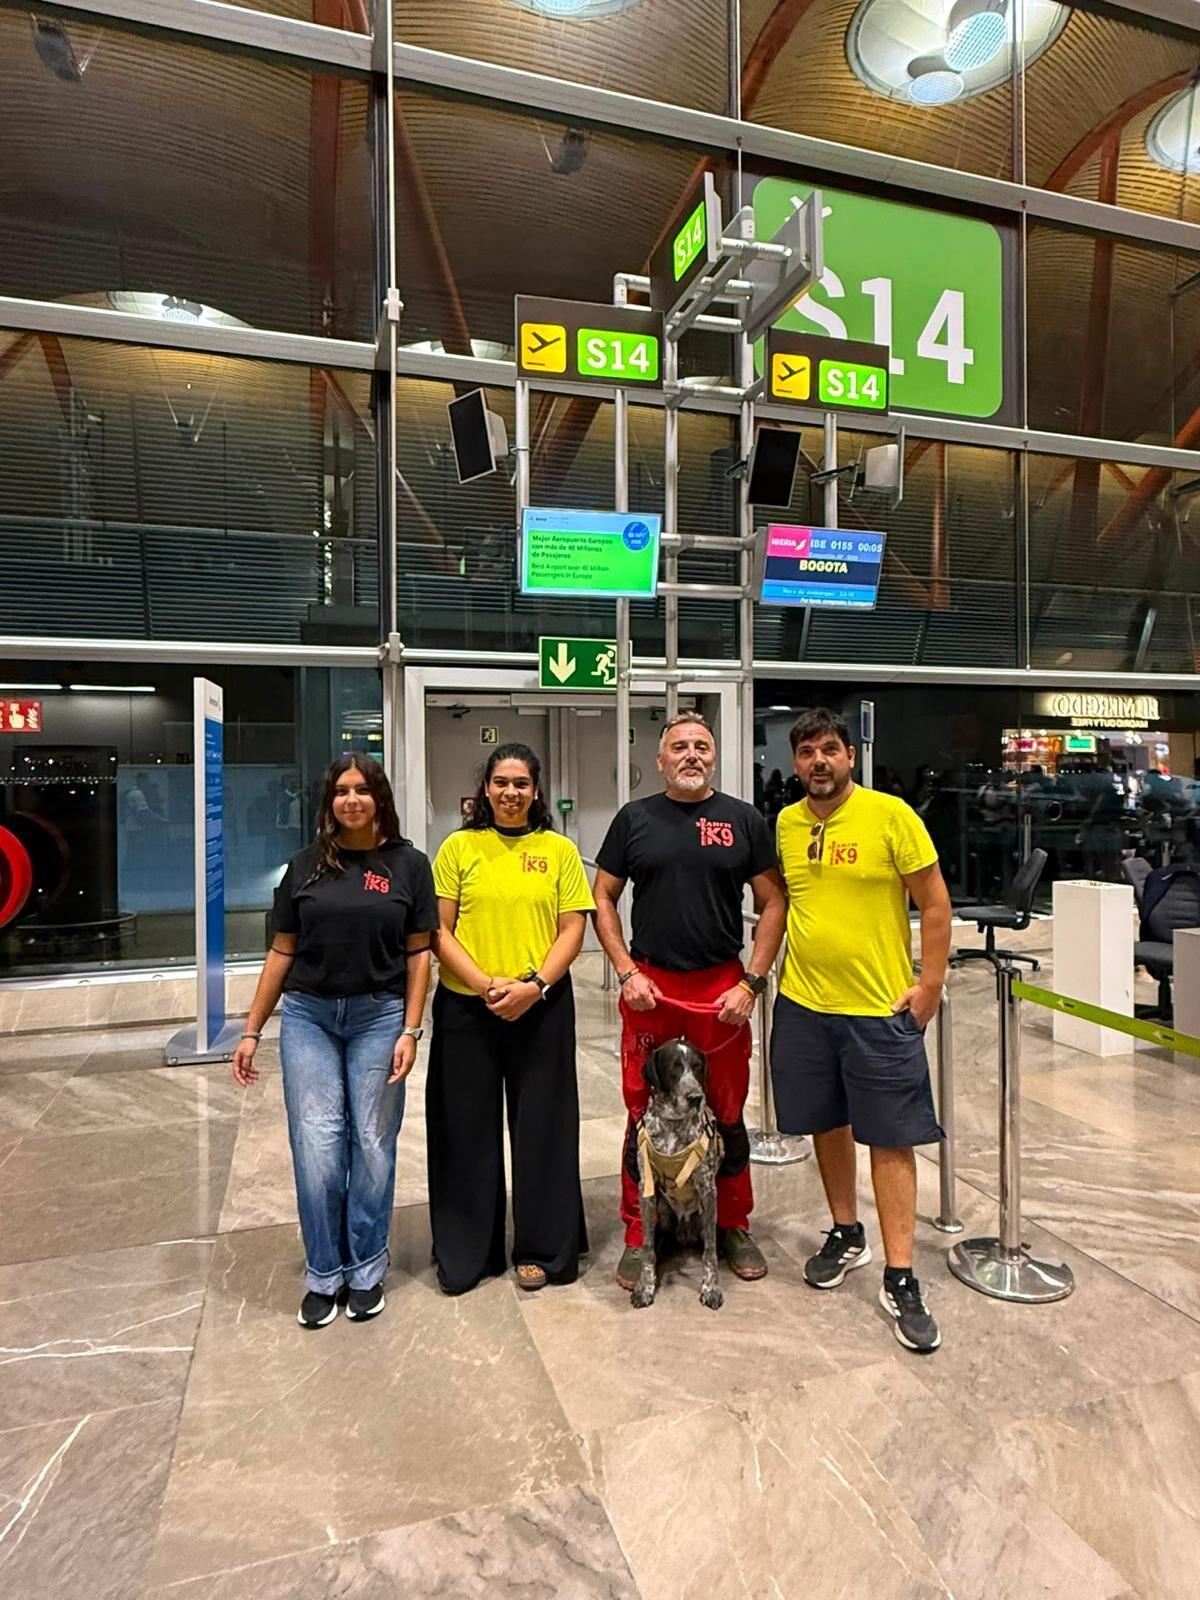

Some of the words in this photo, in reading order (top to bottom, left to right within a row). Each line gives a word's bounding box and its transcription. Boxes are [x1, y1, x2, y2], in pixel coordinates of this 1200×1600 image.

[677, 214, 702, 267] S14
[587, 337, 650, 373] S14
[826, 368, 880, 402] S14
[532, 535, 550, 543] Mejor
[552, 536, 587, 544] Aeropuerto
[771, 538, 797, 547] IBERIA
[810, 539, 826, 548] IBE
[831, 541, 853, 550] 0155
[858, 543, 882, 553] 00:05
[541, 552, 571, 560] Pasajeros
[799, 560, 848, 573] BOGOTA
[706, 827, 734, 847] K9
[836, 847, 857, 864] K9
[527, 860, 548, 873] K9
[369, 878, 389, 893] K9
